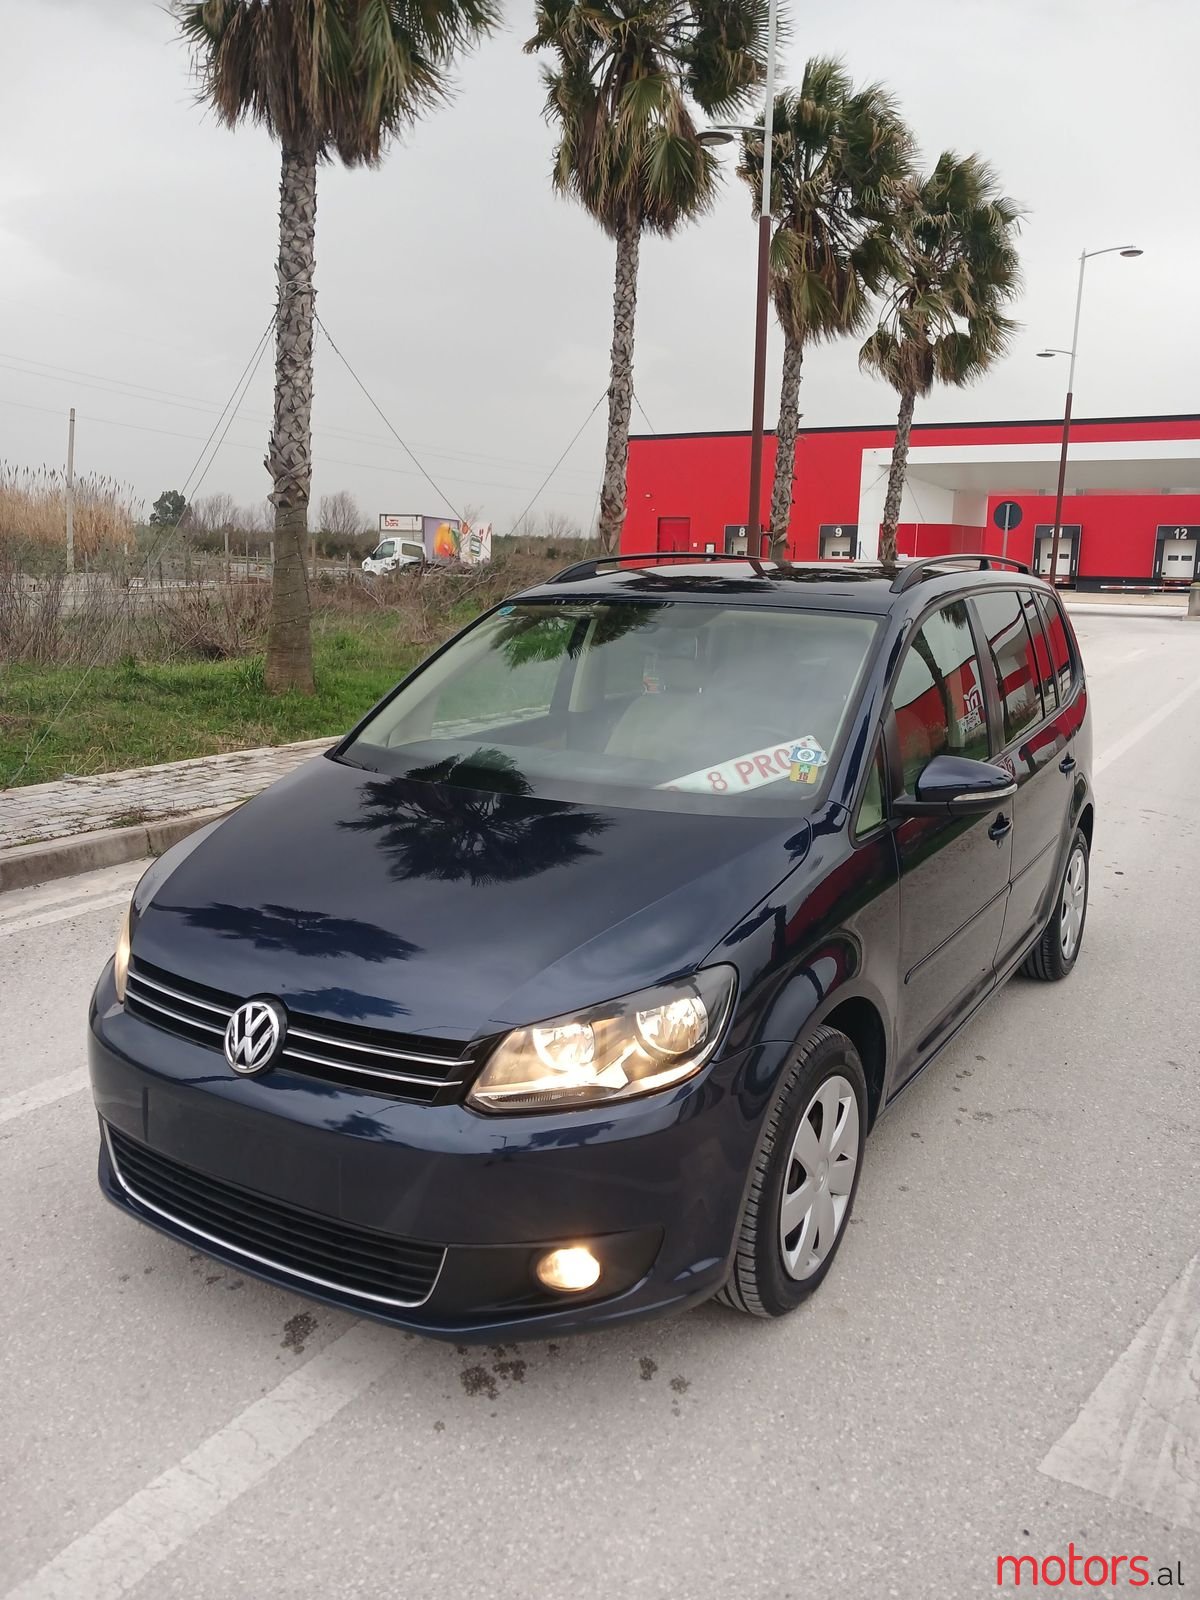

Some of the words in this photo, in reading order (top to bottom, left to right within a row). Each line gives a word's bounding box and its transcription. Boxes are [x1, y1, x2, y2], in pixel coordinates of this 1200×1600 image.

[738, 527, 746, 537] 8
[835, 527, 843, 537] 9
[1174, 528, 1188, 540] 12
[707, 771, 728, 792] 8
